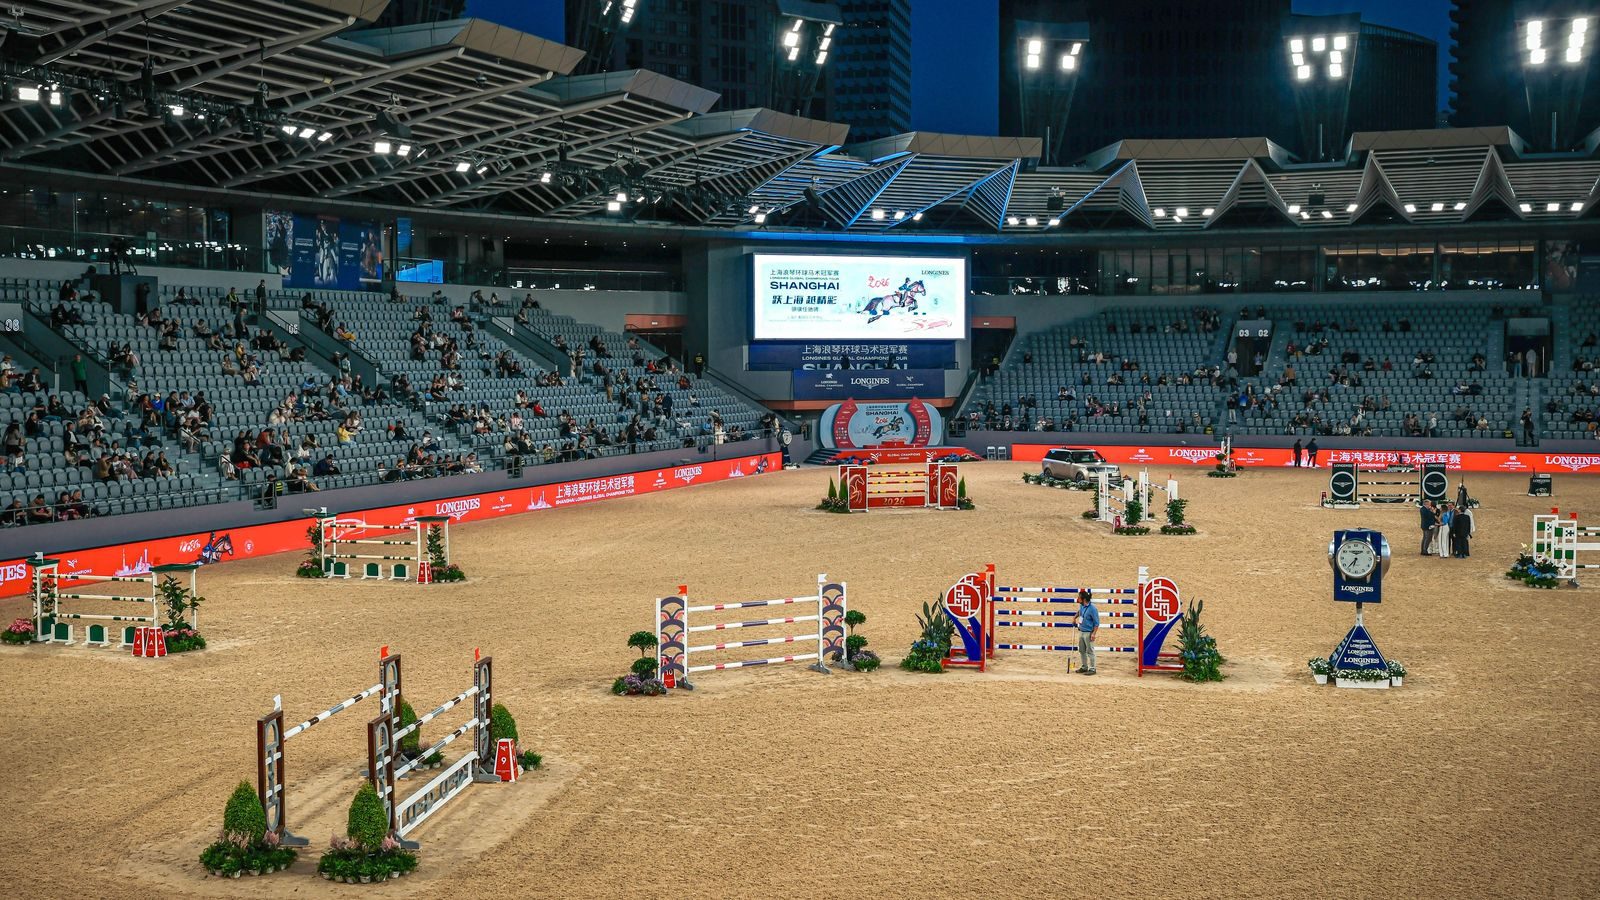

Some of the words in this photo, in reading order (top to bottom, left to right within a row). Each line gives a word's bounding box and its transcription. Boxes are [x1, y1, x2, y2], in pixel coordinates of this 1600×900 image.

[770, 281, 840, 290] SHANGHAI
[802, 344, 908, 354] 上海浪琴环球马术冠军赛
[1170, 448, 1221, 458] LONGINES
[1327, 451, 1461, 464] 上海浪琴环球马术冠军赛
[675, 466, 702, 478] LONGINES
[556, 476, 634, 498] 上海浪琴环球马术冠军赛
[436, 498, 480, 514] LONGINES
[884, 497, 905, 506] 2026
[69, 568, 92, 576] CHAMPIONS
